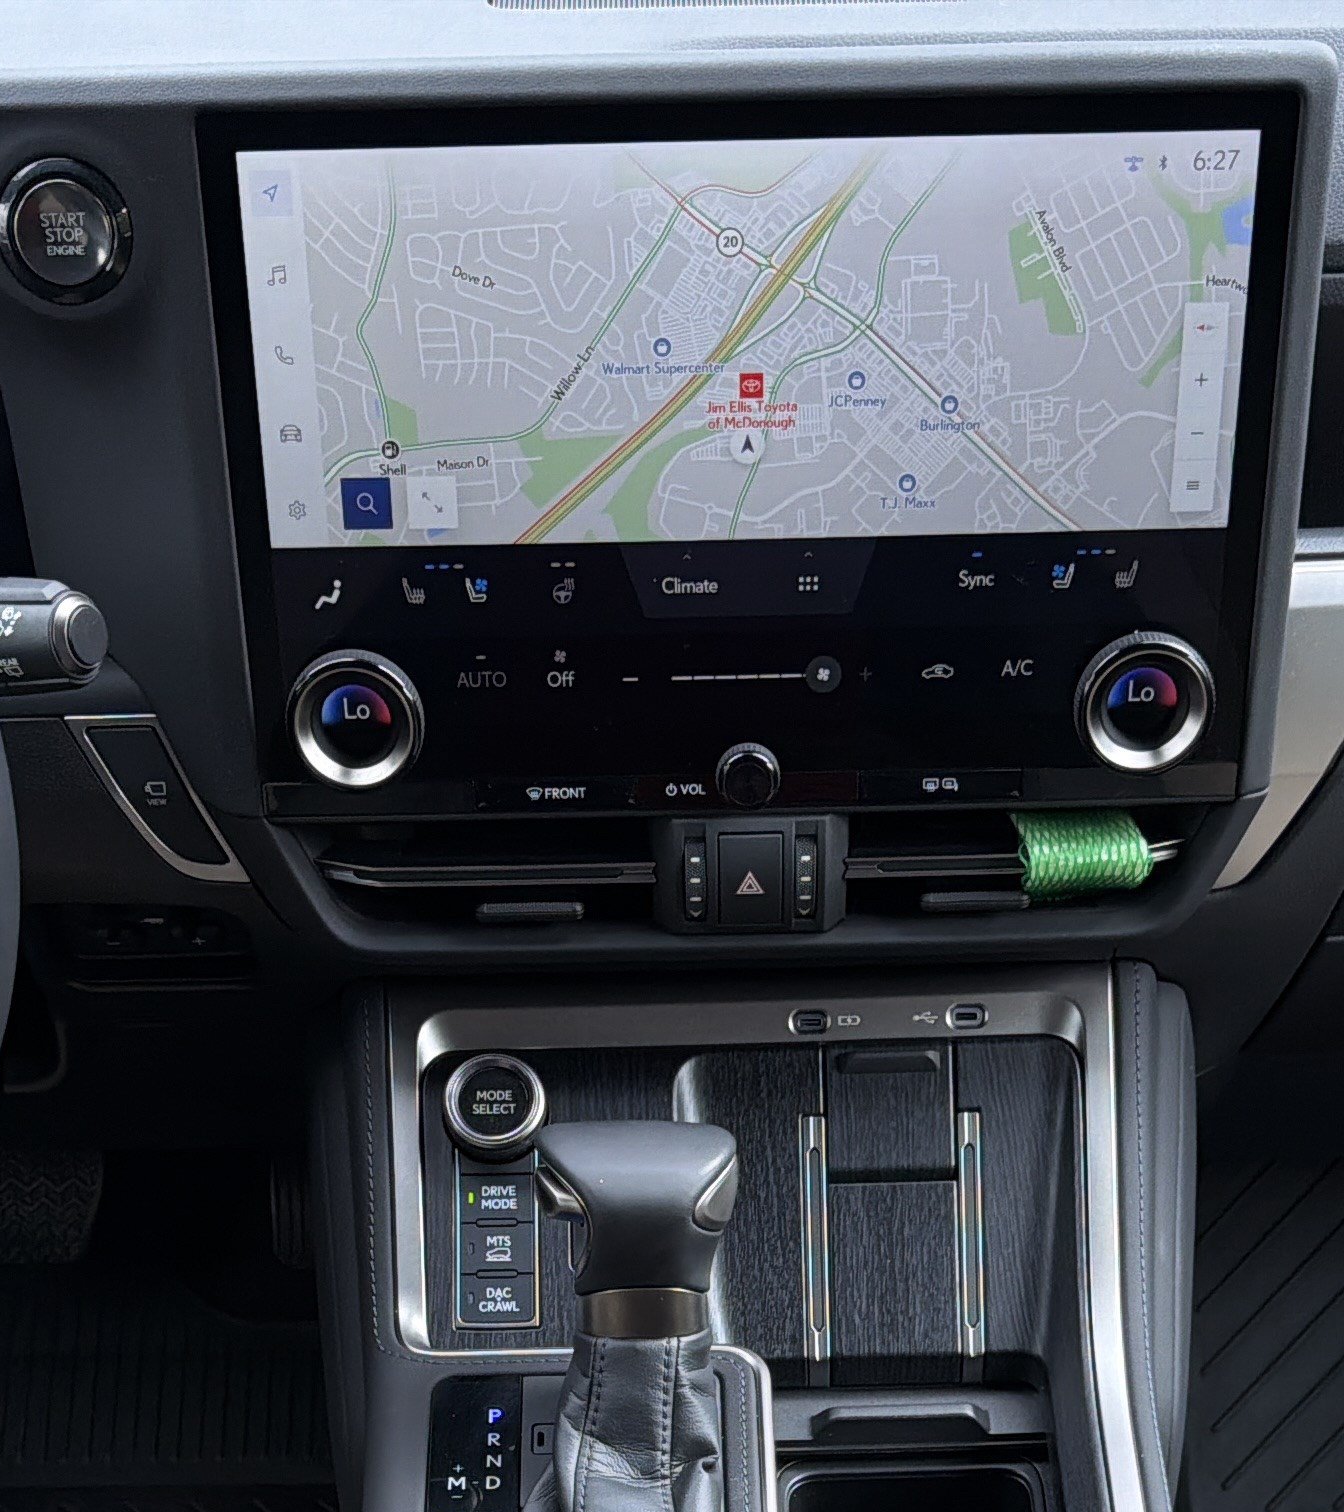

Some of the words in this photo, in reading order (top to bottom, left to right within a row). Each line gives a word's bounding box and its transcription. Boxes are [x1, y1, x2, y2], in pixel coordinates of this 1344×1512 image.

[1192, 149, 1241, 172] 6:27
[40, 212, 86, 227] START
[45, 228, 85, 243] STOP
[722, 235, 739, 248] 20
[1035, 209, 1057, 248] Avalon
[1055, 247, 1072, 273] Blvd
[47, 245, 86, 256] ENGINE
[451, 265, 481, 285] Dove
[481, 275, 497, 290] Dr
[549, 362, 582, 402] Willow
[577, 345, 596, 363] Ln
[602, 363, 651, 376] Walmart
[654, 361, 725, 377] Supercenter
[705, 401, 726, 414] Jim
[729, 401, 753, 413] Ellis
[757, 400, 798, 415] Toyota
[828, 395, 887, 409] JCPenney
[708, 417, 721, 430] of
[724, 416, 796, 431] McDonough
[920, 419, 981, 433] Burlington
[379, 464, 407, 476] Shell
[437, 459, 475, 472] Maison
[476, 456, 489, 468] Dr
[880, 497, 900, 509] T.J.
[904, 496, 936, 509] Maxx
[661, 576, 719, 595] Climate
[958, 569, 995, 591] Sync
[1000, 659, 1035, 678] A/C
[456, 670, 507, 689] AUTO
[546, 670, 576, 688] Off
[1127, 679, 1155, 703] Lo
[342, 697, 370, 720] Lo
[544, 786, 586, 800] FRONT
[679, 783, 707, 796] VOL
[147, 798, 167, 806] VIEW
[476, 1089, 513, 1102] MODE
[472, 1103, 517, 1115] SELECT
[481, 1185, 517, 1197] DRIVE
[481, 1198, 518, 1210] MODE
[486, 1235, 512, 1247] MTS
[486, 1287, 513, 1299] DAC
[478, 1300, 520, 1313] CRAWL
[488, 1408, 502, 1424] P
[487, 1432, 501, 1447] R
[486, 1454, 502, 1468] N
[447, 1476, 467, 1490] M
[485, 1476, 501, 1490] D
